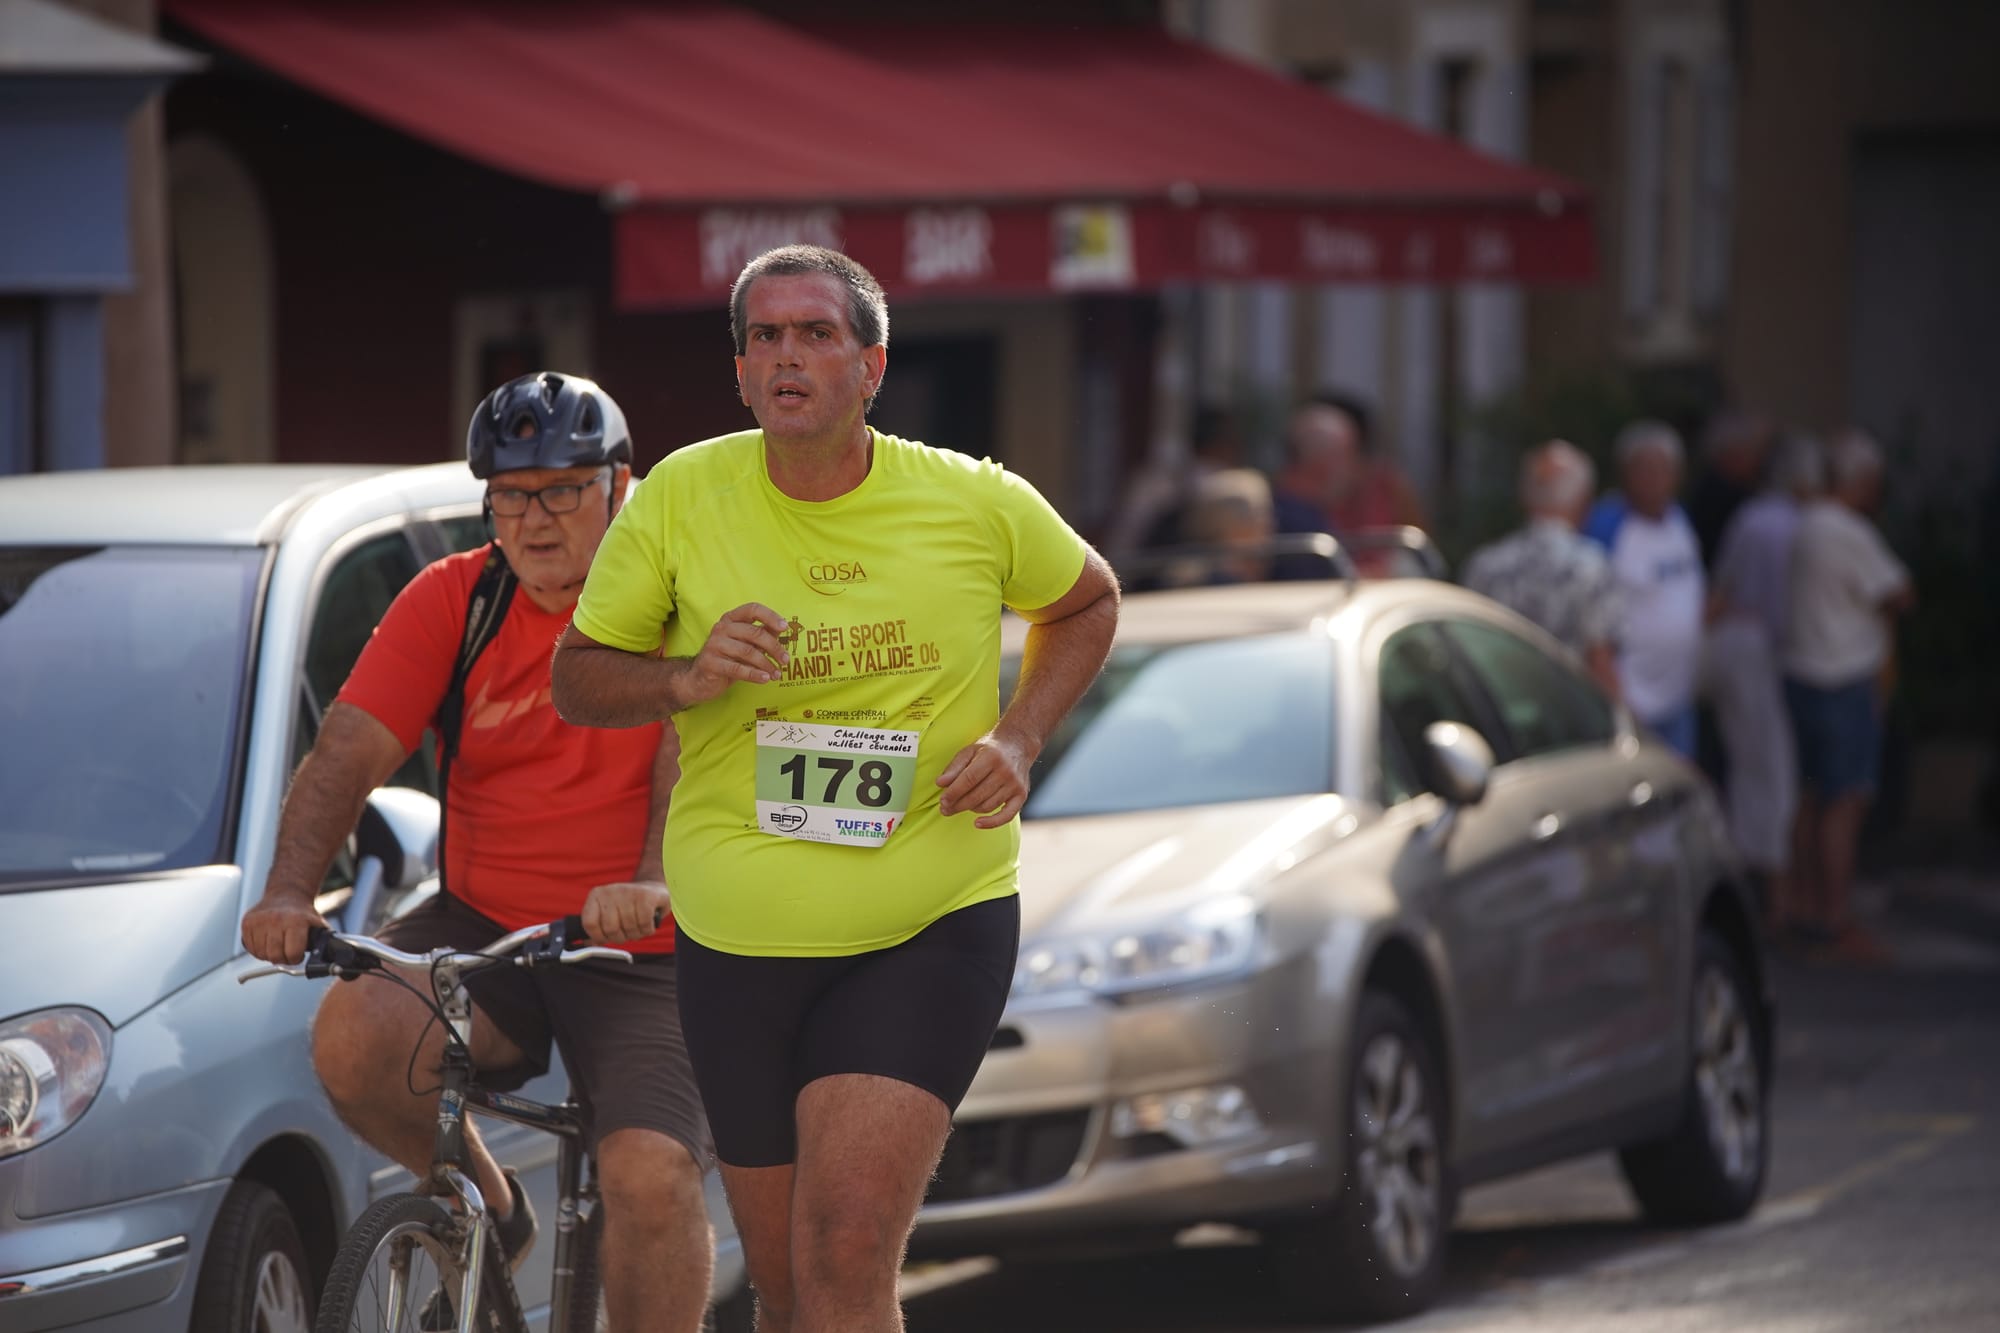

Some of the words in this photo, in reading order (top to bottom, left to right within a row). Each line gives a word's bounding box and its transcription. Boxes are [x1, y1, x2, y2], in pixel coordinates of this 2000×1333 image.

[809, 561, 867, 581] CDSA
[806, 622, 844, 653] DÉFI
[849, 619, 907, 649] SPORT
[780, 654, 832, 681] HANDI
[851, 645, 915, 673] VALIDE
[919, 641, 940, 665] 06
[829, 675, 849, 683] SPORT
[816, 709, 850, 717] CONSEIL
[850, 707, 888, 717] GÉNÉRAL
[834, 729, 885, 743] Challenge
[891, 734, 908, 742] des
[828, 739, 863, 749] vallées
[869, 739, 912, 752] cévenoles
[780, 753, 893, 808] 178
[770, 813, 802, 824] BFP
[835, 819, 883, 832] TUFF'S
[839, 827, 886, 839] Aventure
